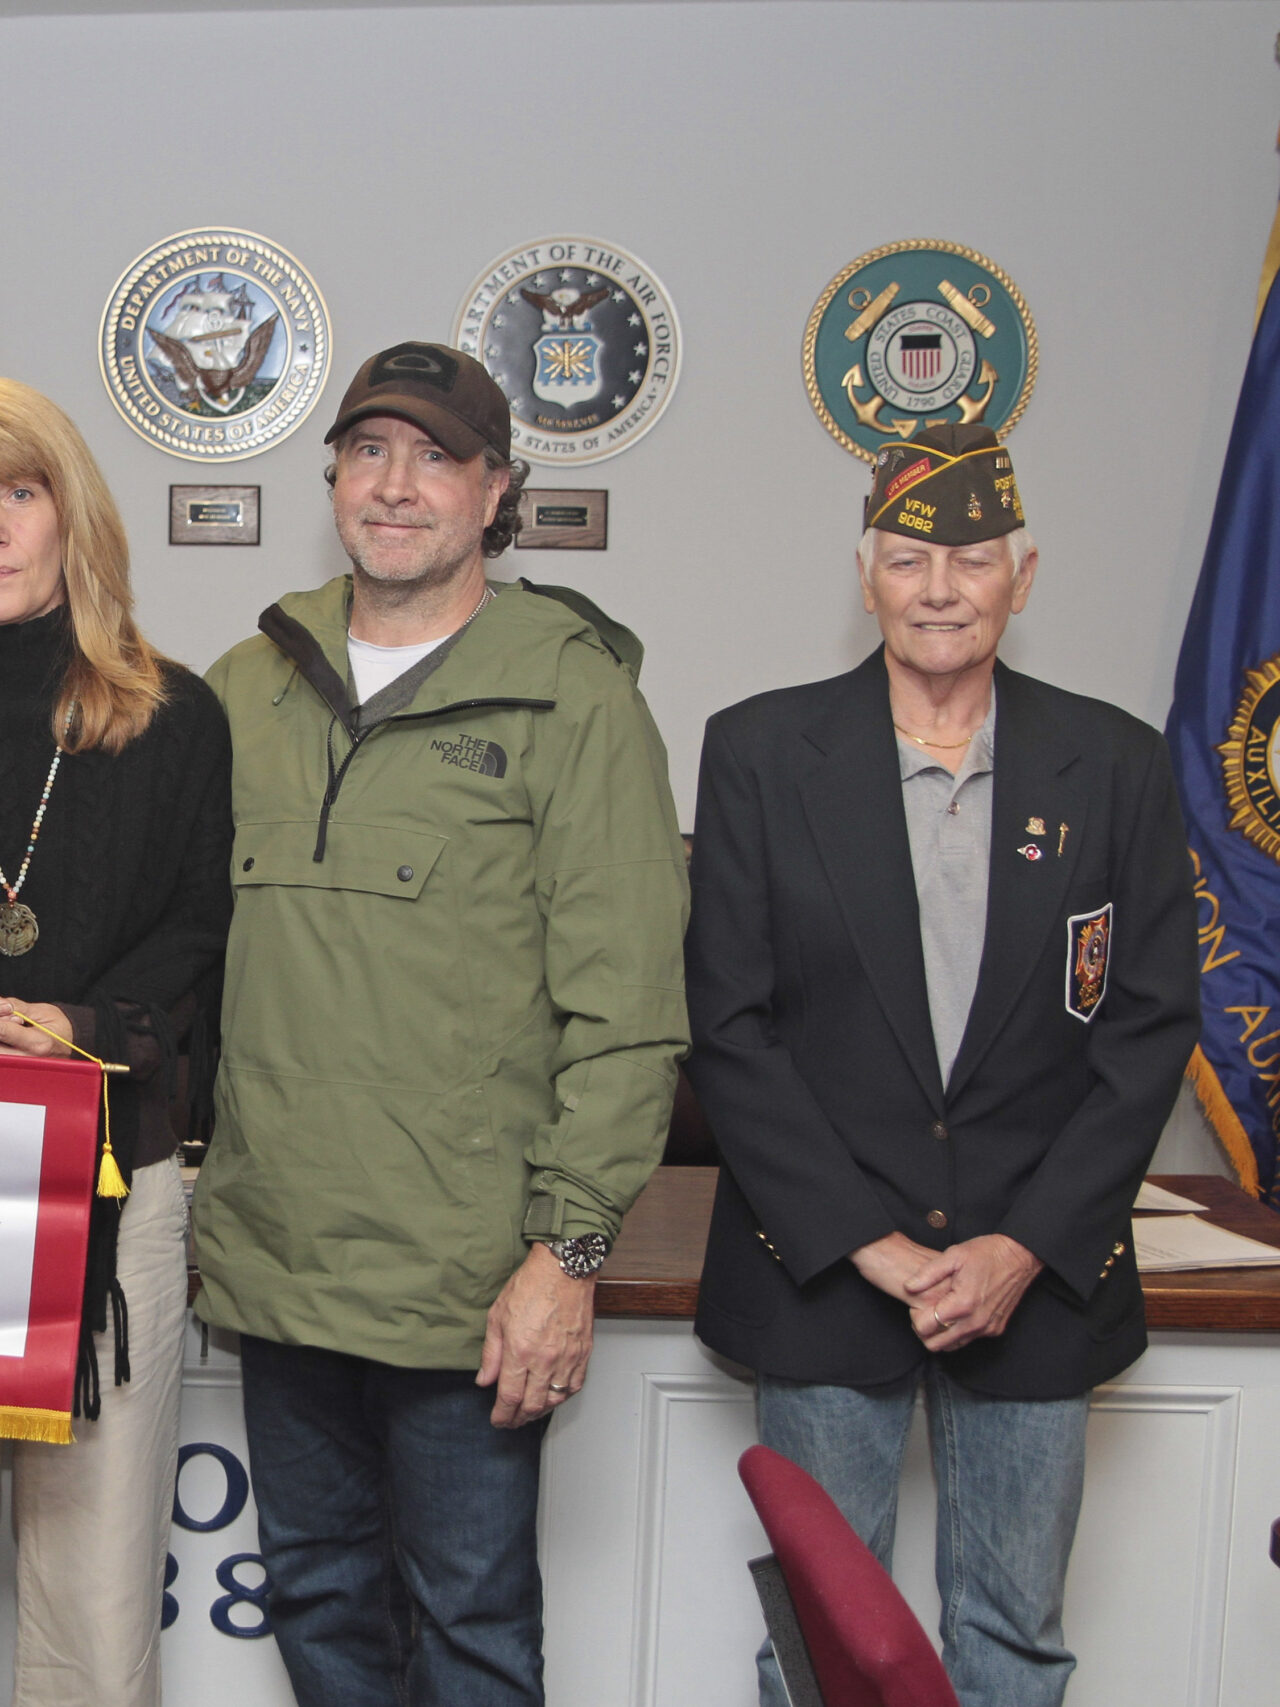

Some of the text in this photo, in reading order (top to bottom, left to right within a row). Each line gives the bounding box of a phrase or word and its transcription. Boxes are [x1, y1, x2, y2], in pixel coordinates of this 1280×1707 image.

[122, 248, 312, 332] DEPARTMENT OF THE NAVY
[550, 244, 577, 262] OF
[584, 246, 626, 276] THE
[626, 274, 657, 306] AIR
[650, 311, 672, 387] FORCE
[870, 307, 971, 400] UNITED STATES COAST GUARD
[120, 355, 310, 442] UNITED STATES OF AMERICA
[525, 434, 576, 454] STATES
[583, 439, 601, 454] OF
[608, 394, 657, 442] AMERICA
[898, 463, 926, 486] MEMBER
[905, 498, 937, 517] VFW
[897, 512, 934, 533] 9082
[430, 740, 484, 762] NORTH
[458, 733, 487, 751] THE
[441, 753, 479, 772] FACE
